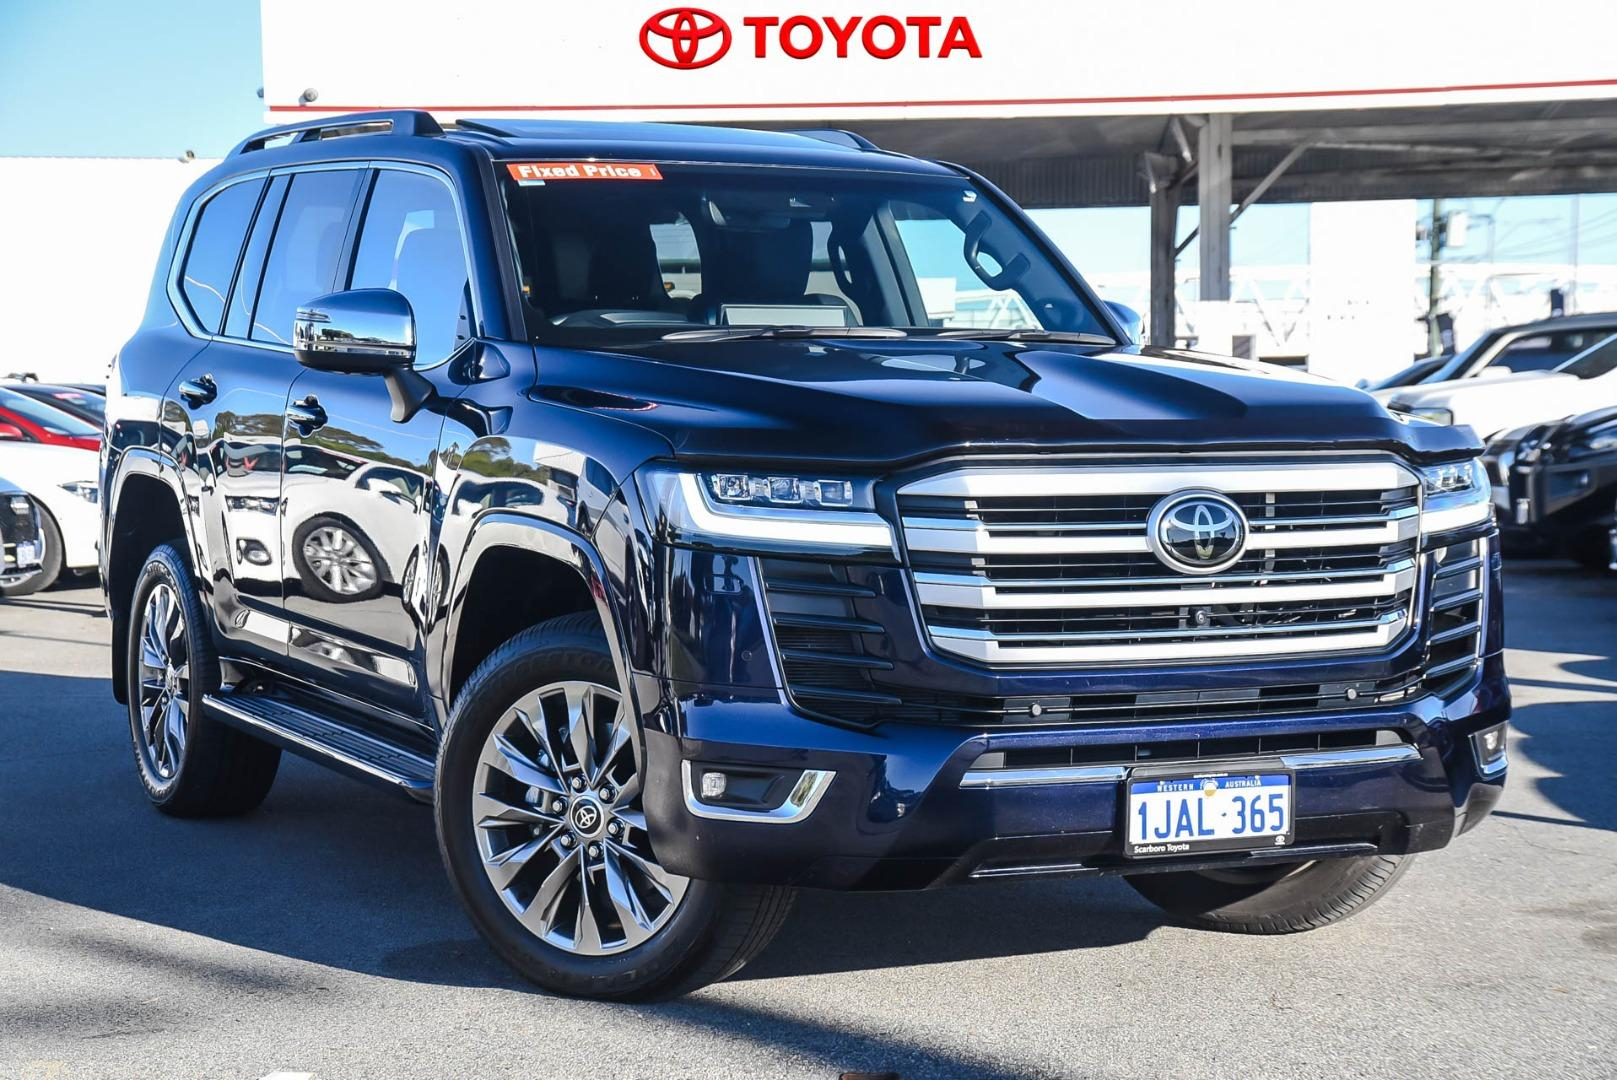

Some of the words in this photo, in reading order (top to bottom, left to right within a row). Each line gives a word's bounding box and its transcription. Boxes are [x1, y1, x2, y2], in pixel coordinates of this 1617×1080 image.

[743, 15, 982, 59] TOYOTA
[517, 164, 580, 178] Fixed
[583, 164, 642, 177] Price
[1156, 783, 1194, 792] WESTERN
[1225, 779, 1262, 788] AUSTRALIA
[1138, 798, 1215, 840] 1JAL
[1232, 793, 1284, 835] 365
[1134, 844, 1165, 854] Scarboro
[1166, 843, 1190, 853] Toyota
